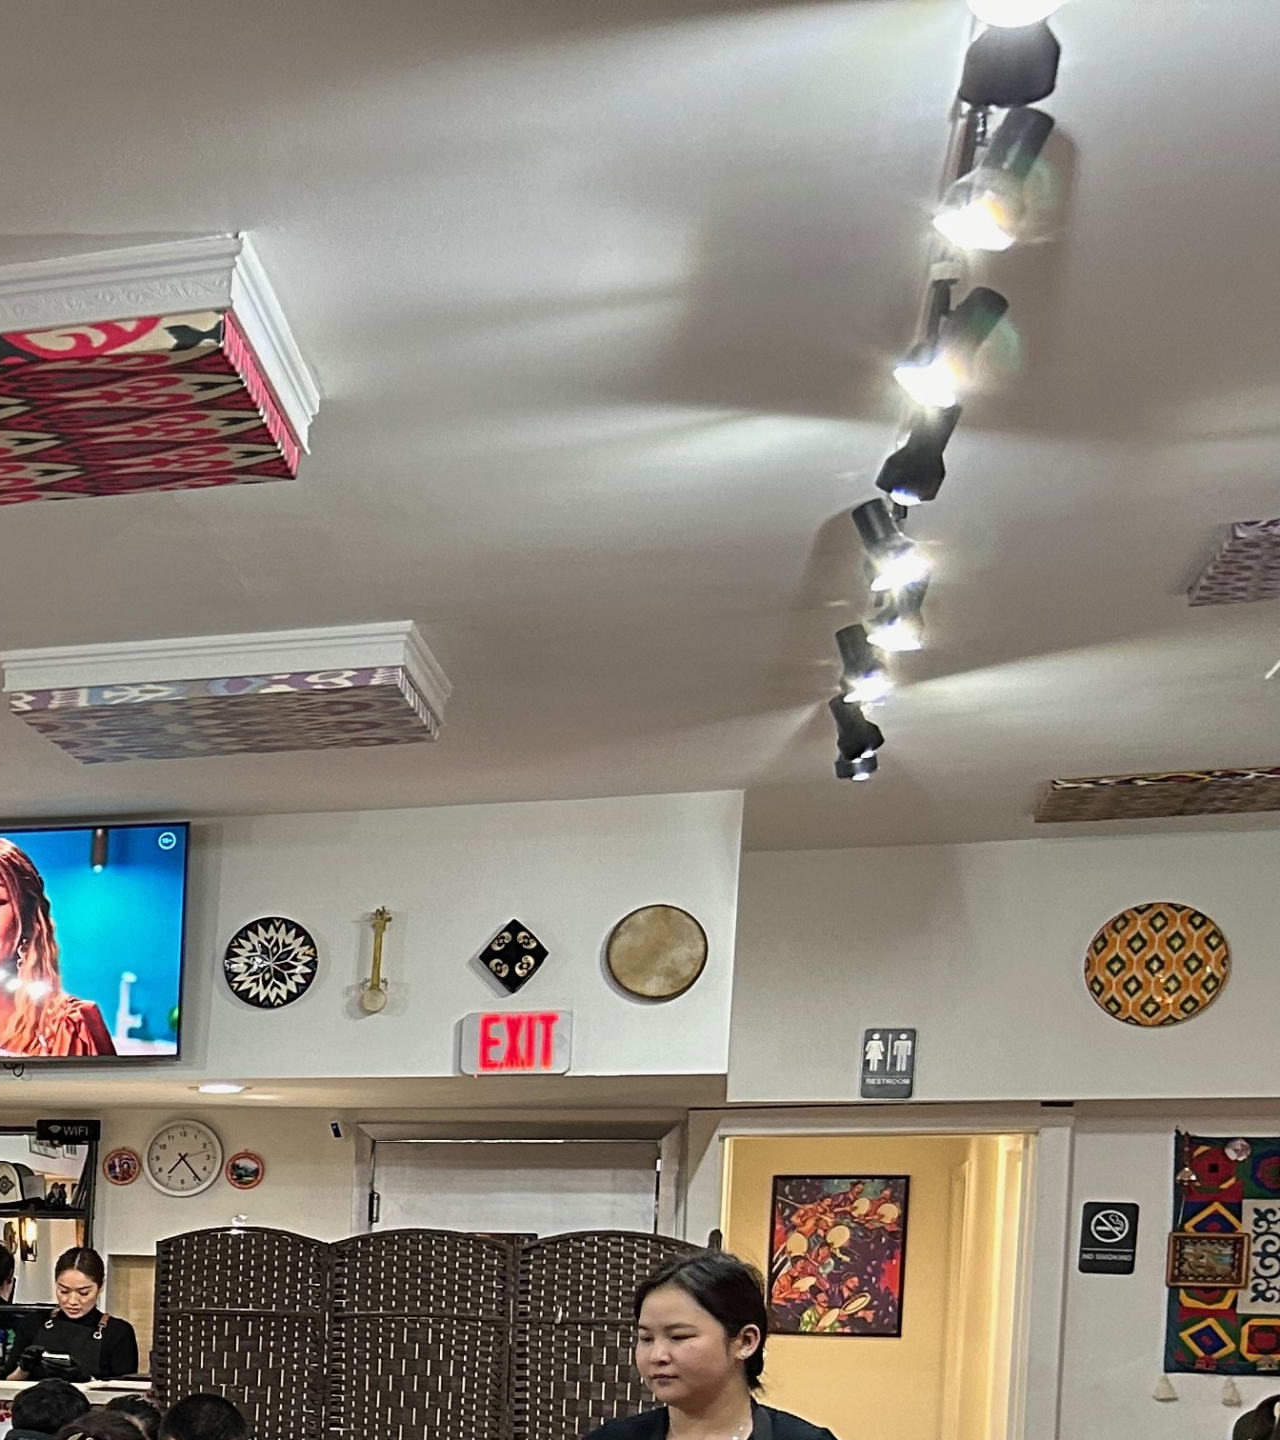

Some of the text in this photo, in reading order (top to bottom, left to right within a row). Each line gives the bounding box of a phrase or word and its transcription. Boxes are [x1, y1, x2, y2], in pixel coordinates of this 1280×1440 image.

[480, 1012, 559, 1070] EXIT
[63, 1126, 89, 1136] WIFI
[1095, 1253, 1133, 1262] SMOKING
